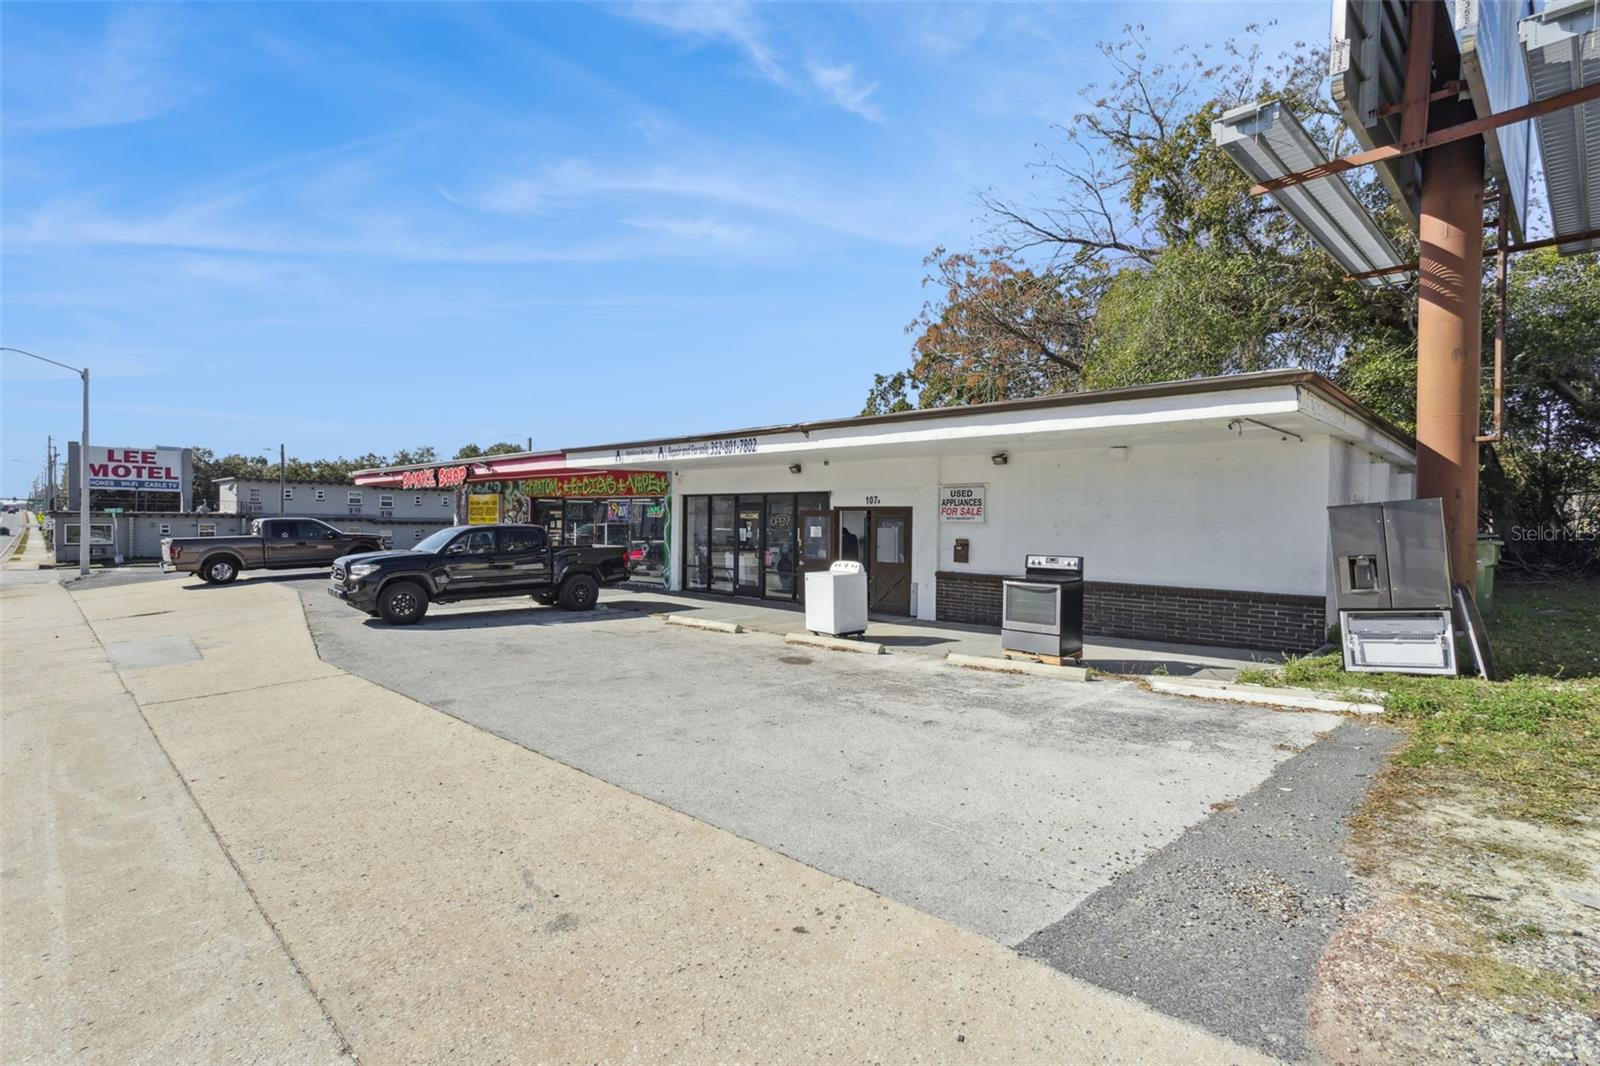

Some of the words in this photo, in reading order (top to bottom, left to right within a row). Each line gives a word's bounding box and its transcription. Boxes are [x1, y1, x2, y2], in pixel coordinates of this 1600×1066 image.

[710, 438, 757, 455] 352-801-7802
[107, 449, 157, 464] LEE
[402, 469, 436, 489] SMOKE
[438, 465, 467, 488] SHOP
[950, 489, 973, 498] USED
[941, 498, 983, 507] APPLIANCES
[739, 512, 760, 520] WELCOME
[940, 507, 958, 516] FOR
[959, 507, 983, 516] SALE
[770, 515, 790, 527] OPEN
